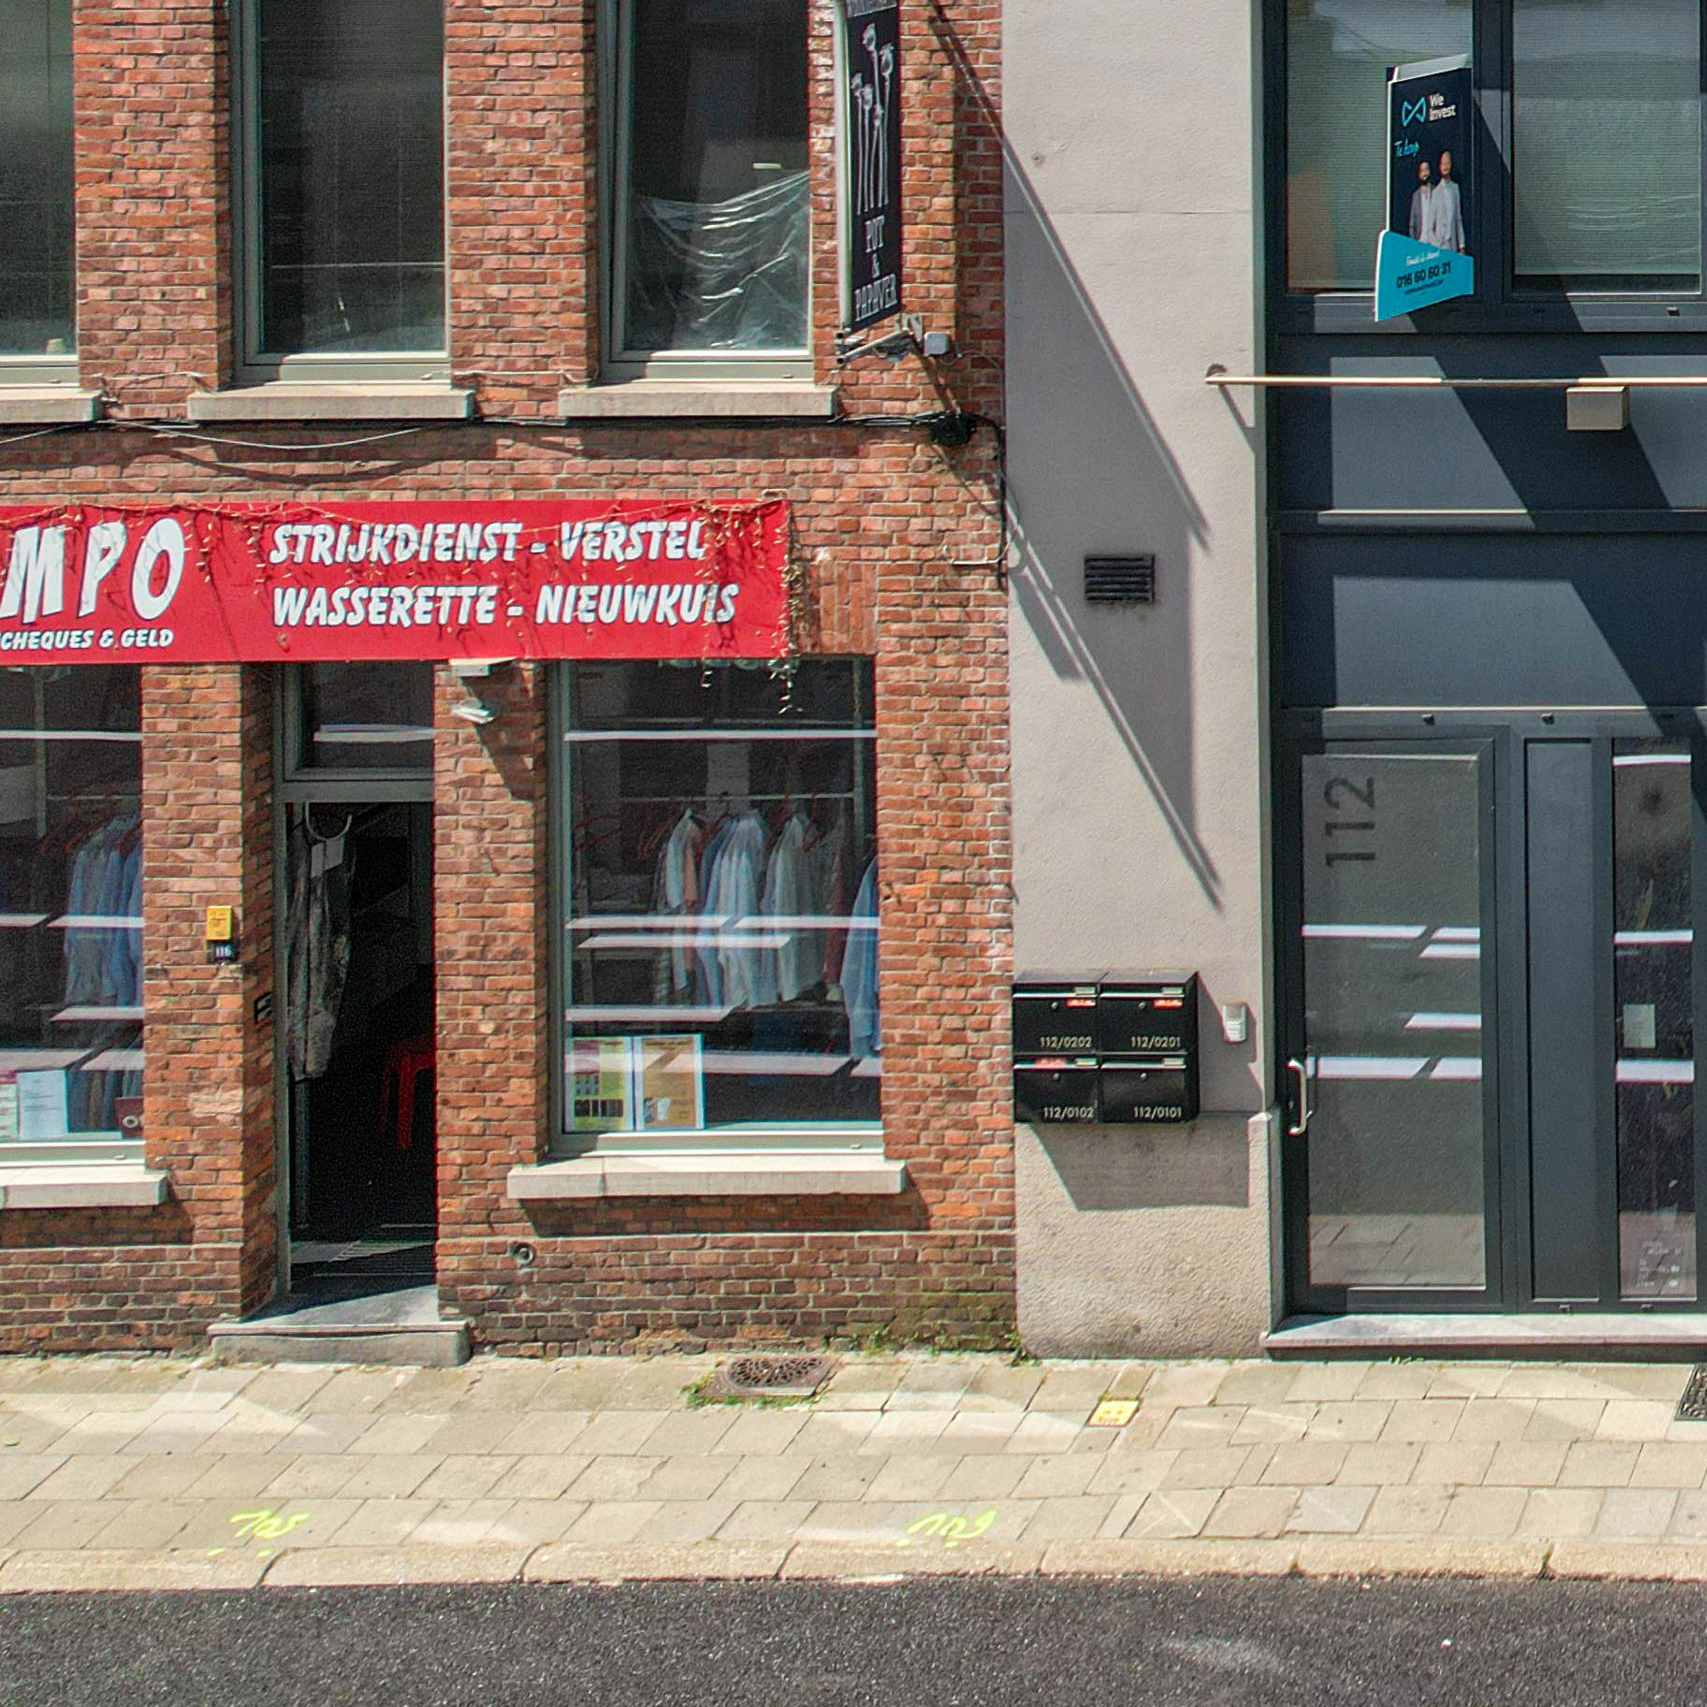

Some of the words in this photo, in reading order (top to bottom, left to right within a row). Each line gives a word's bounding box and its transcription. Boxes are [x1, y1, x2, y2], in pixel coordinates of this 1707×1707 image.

[1430, 93, 1444, 106] We
[1429, 105, 1456, 121] Invest
[1396, 273, 1413, 288] 016
[1414, 269, 1426, 283] 60
[1428, 265, 1440, 279] 60
[269, 522, 523, 566] STRIJKDIENST
[529, 542, 547, 554] -
[560, 520, 705, 563] VERSTEL
[273, 584, 499, 629] WASSERETTE
[506, 605, 524, 617] -
[535, 583, 740, 627] NIEUWKUIS
[0, 629, 95, 651] CHEQUES
[99, 629, 114, 648] &
[120, 628, 174, 648] GELD
[1324, 777, 1376, 868] 112
[1040, 1036, 1093, 1049] 112/0202
[1131, 1036, 1181, 1049] 112/0201
[1043, 1106, 1095, 1120] 112/0102
[1133, 1106, 1183, 1120] 112/0101
